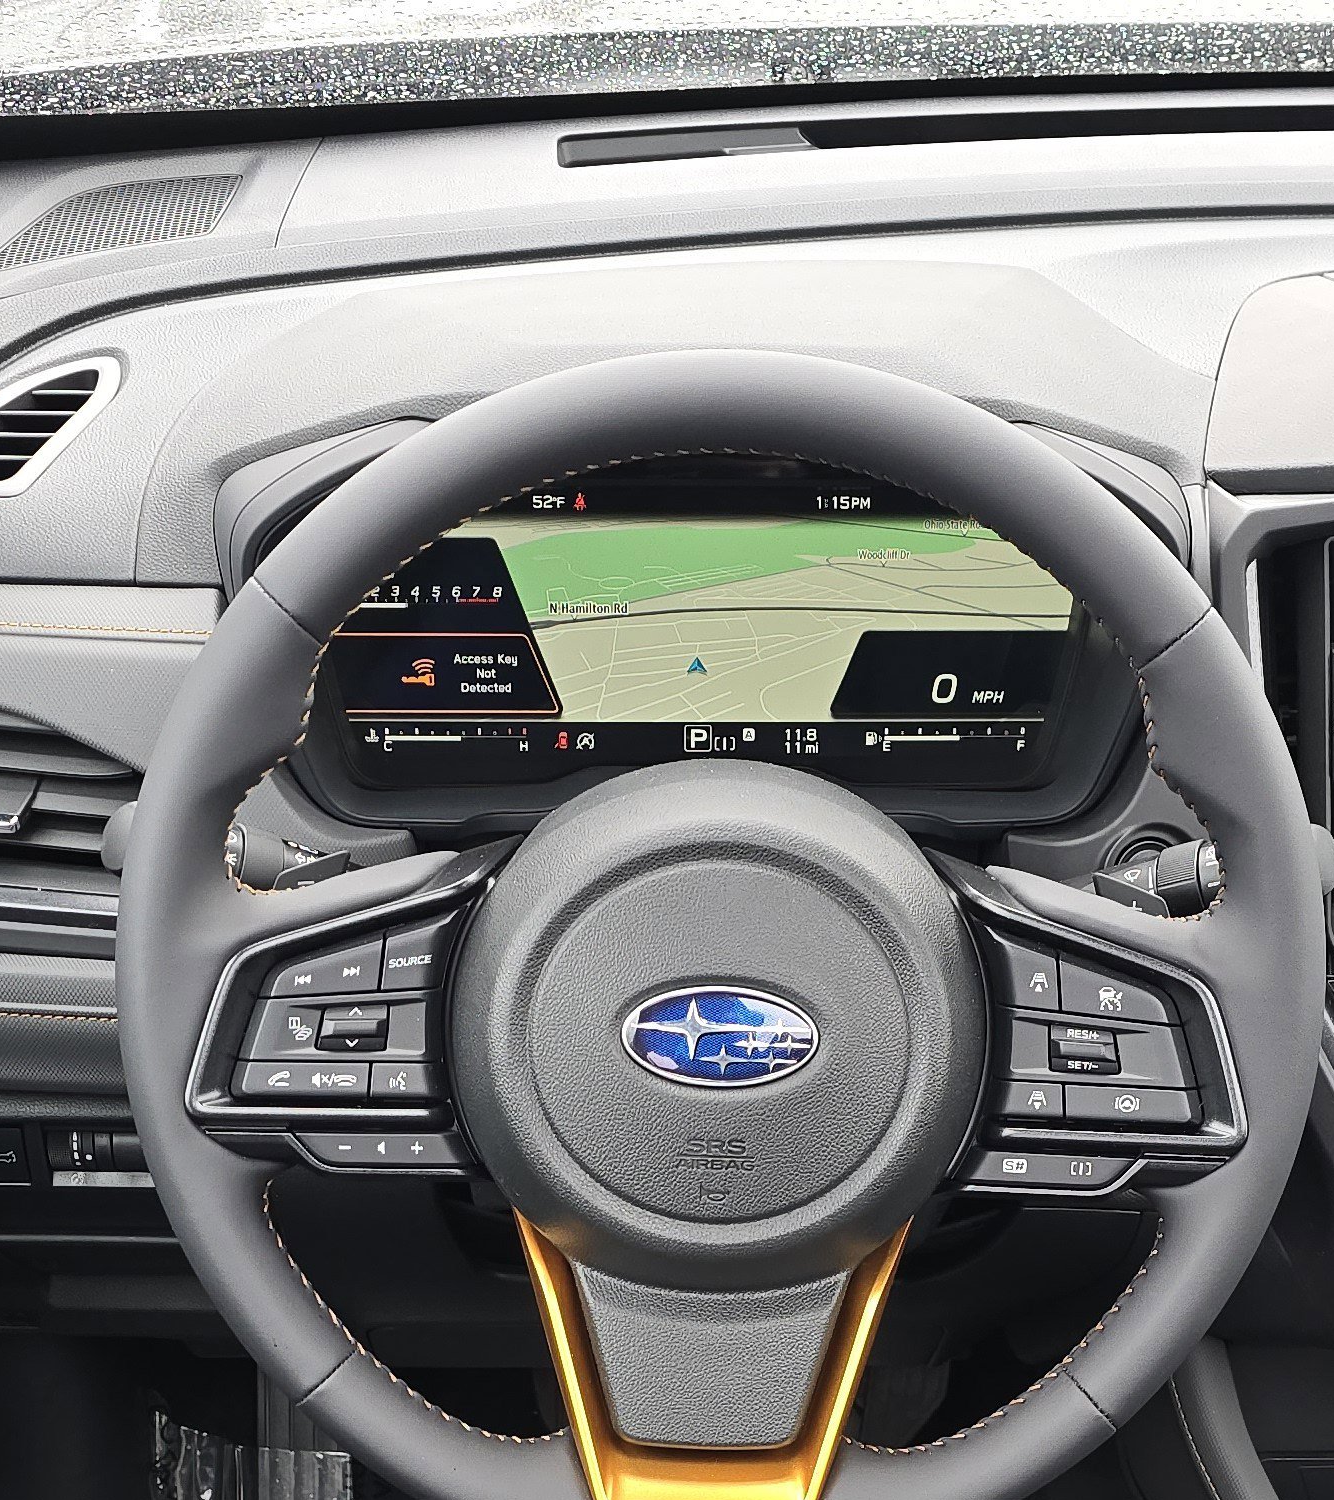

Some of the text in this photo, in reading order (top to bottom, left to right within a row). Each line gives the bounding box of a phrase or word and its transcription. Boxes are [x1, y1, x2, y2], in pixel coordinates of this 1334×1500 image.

[924, 518, 944, 530] Ohio
[946, 518, 968, 530] State
[858, 549, 911, 560] Woodcliff Dr
[391, 586, 401, 597] 3
[411, 586, 421, 597] 4
[431, 586, 441, 597] 5
[452, 586, 462, 597] 6
[472, 586, 482, 597] 7
[492, 586, 502, 597] 8
[549, 602, 628, 614] N Hamilton Rd
[453, 653, 518, 667] Access Key
[476, 668, 496, 679] Not
[460, 682, 512, 693] Detected
[931, 673, 1005, 704] 0 MPH
[689, 728, 708, 749] P
[383, 740, 529, 752] C H
[804, 741, 819, 754] mi
[882, 740, 1026, 752] E F
[388, 954, 432, 969] SOURCE
[1066, 1028, 1100, 1040] RES/+
[686, 1139, 747, 1156] SRS
[676, 1158, 756, 1171] AIRBAG
